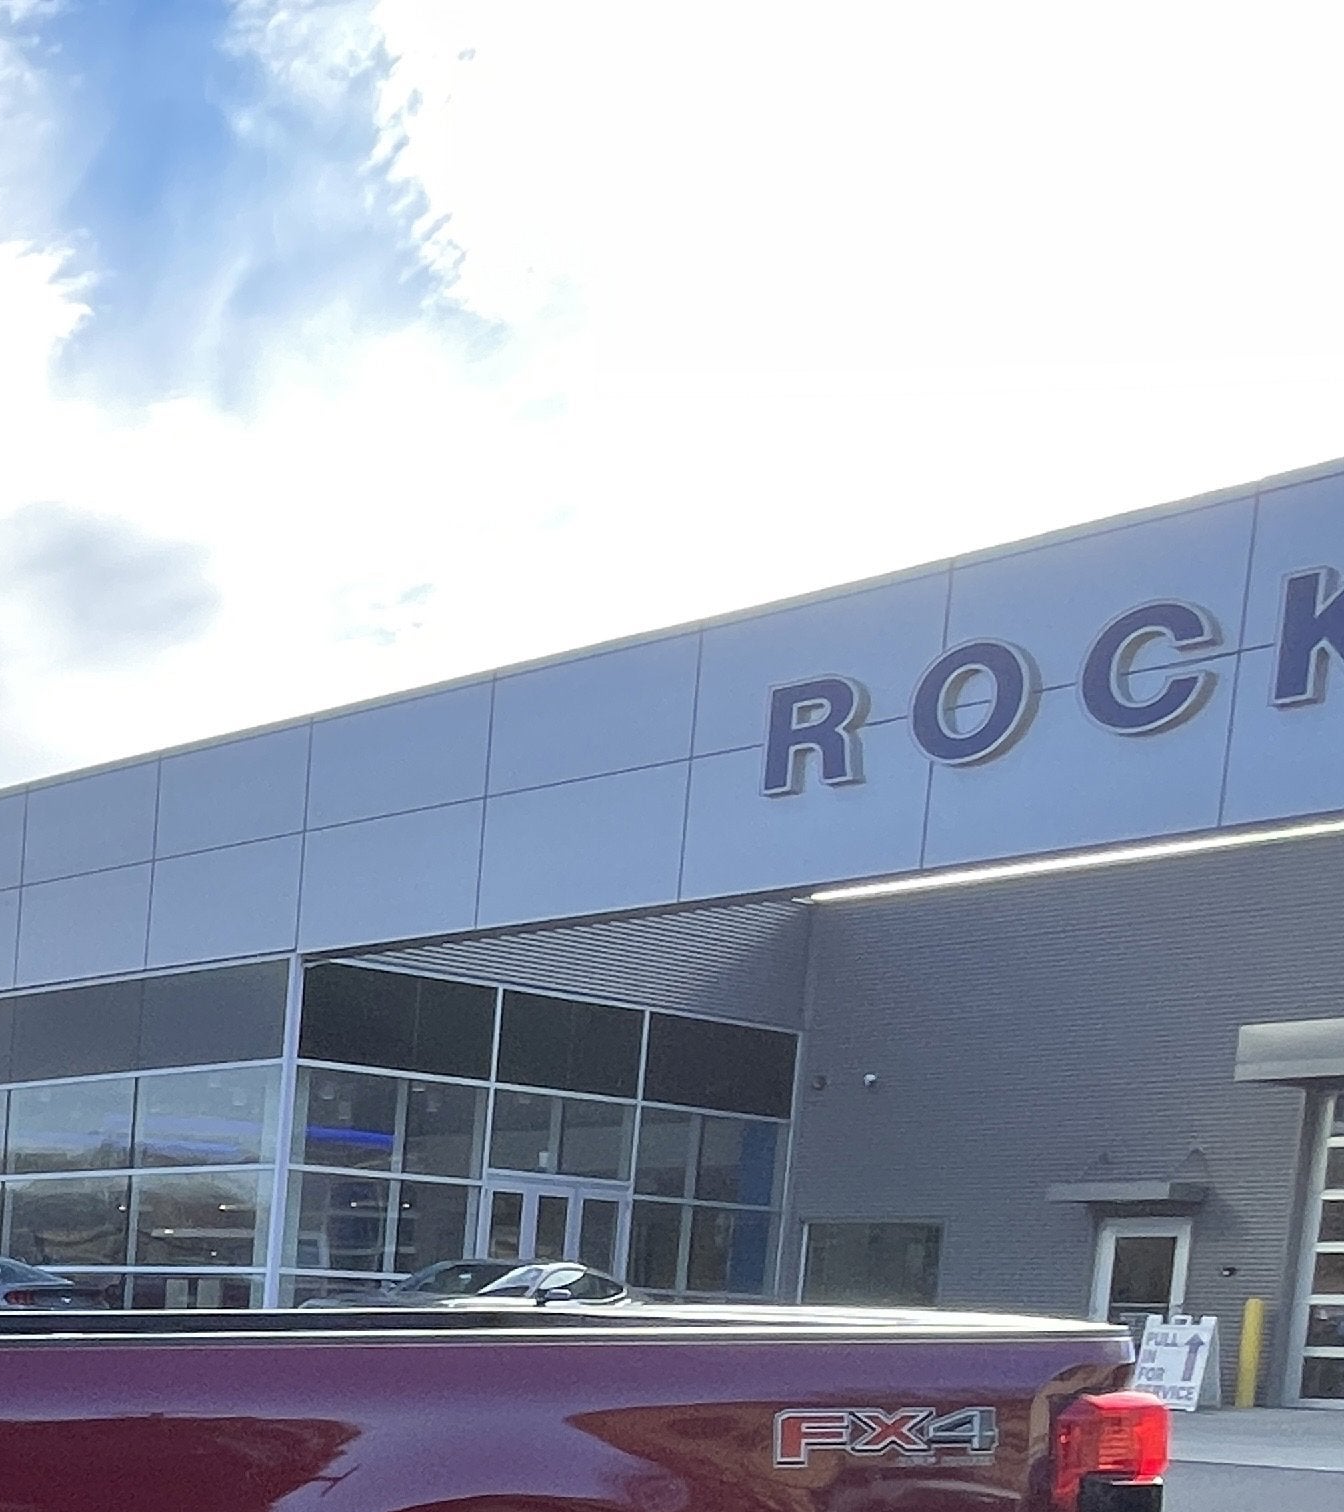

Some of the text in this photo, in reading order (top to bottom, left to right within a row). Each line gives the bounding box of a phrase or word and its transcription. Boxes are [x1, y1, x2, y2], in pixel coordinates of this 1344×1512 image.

[760, 566, 1344, 796] ROCK
[1145, 1332, 1183, 1347] PULL
[1138, 1366, 1165, 1381] FOR
[773, 1407, 999, 1468] FX4
